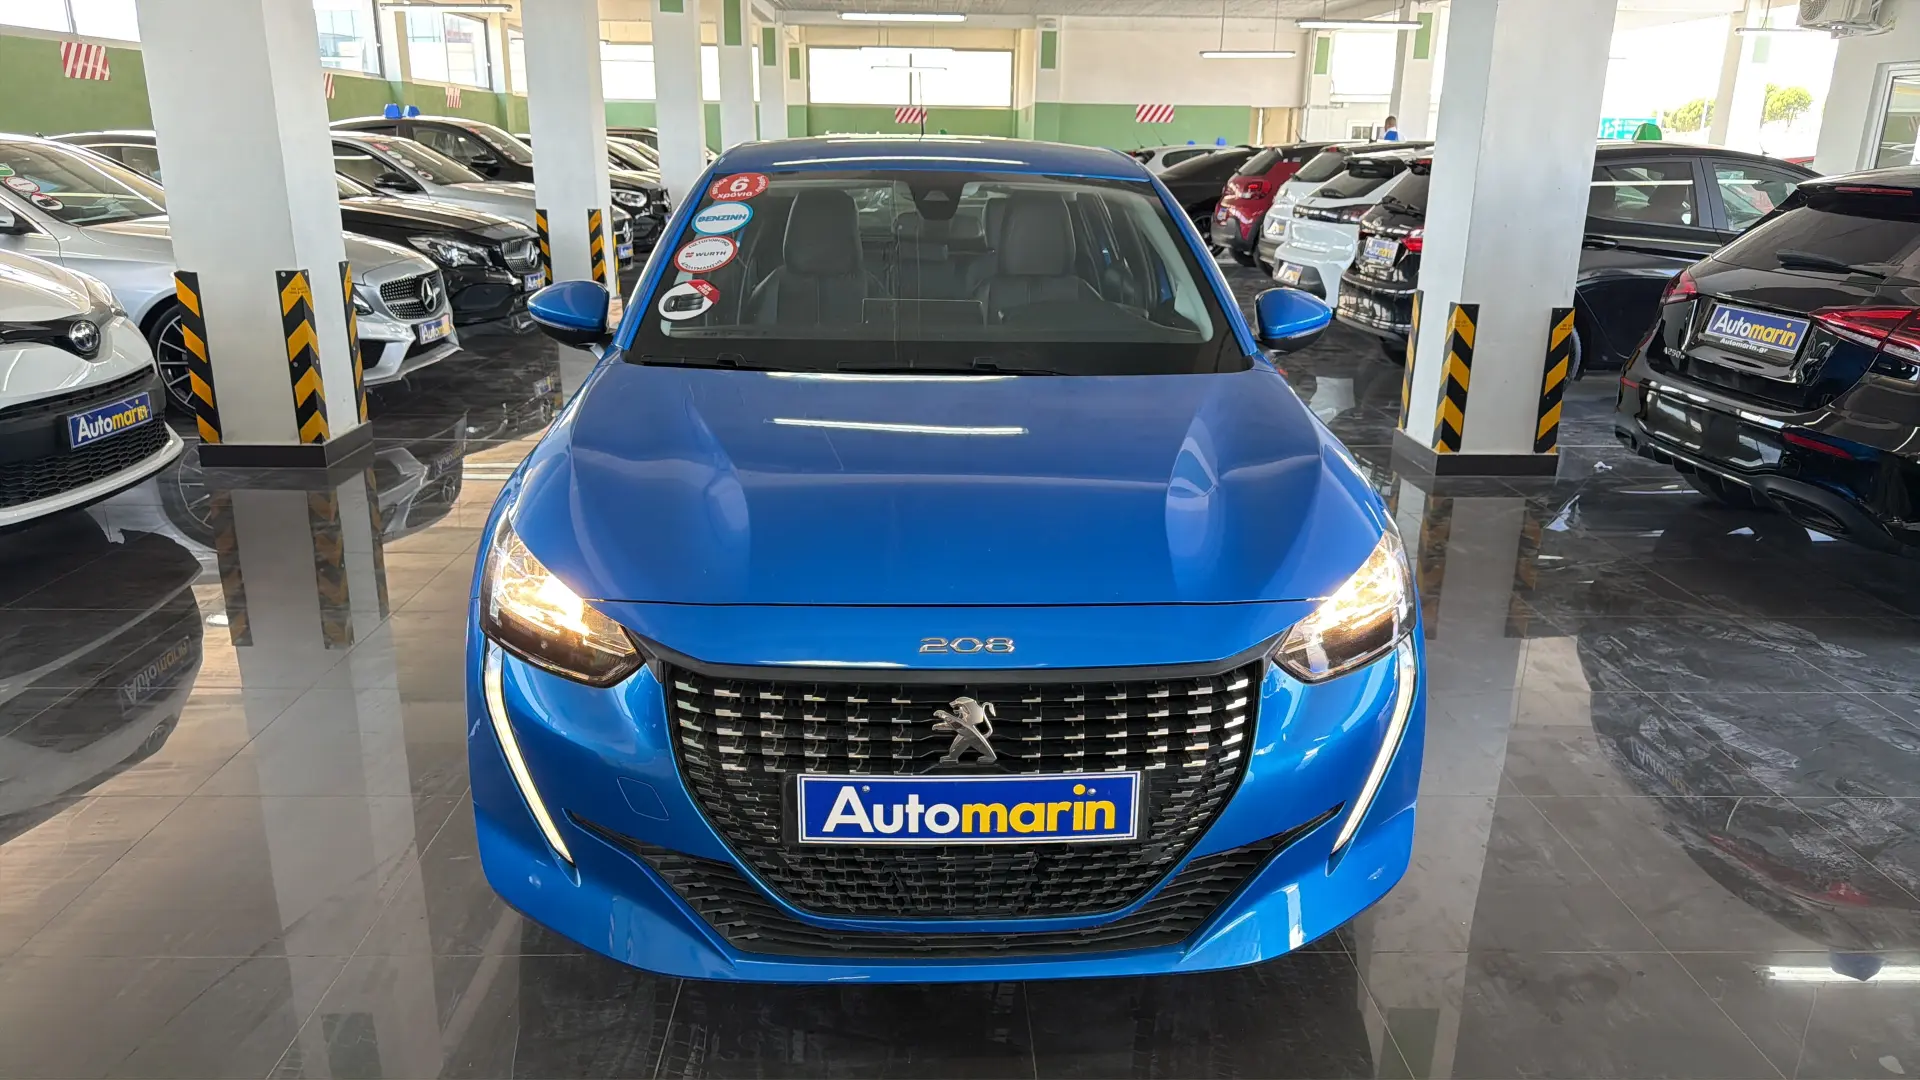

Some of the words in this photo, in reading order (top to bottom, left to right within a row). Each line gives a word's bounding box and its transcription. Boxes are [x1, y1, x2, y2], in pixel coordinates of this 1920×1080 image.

[730, 177, 750, 192] 6
[1713, 310, 1797, 347] Automarin
[1720, 337, 1769, 354] Automarin.gr
[77, 398, 149, 443] Automarin
[919, 636, 1015, 654] 208
[821, 783, 1116, 834] Automarin
